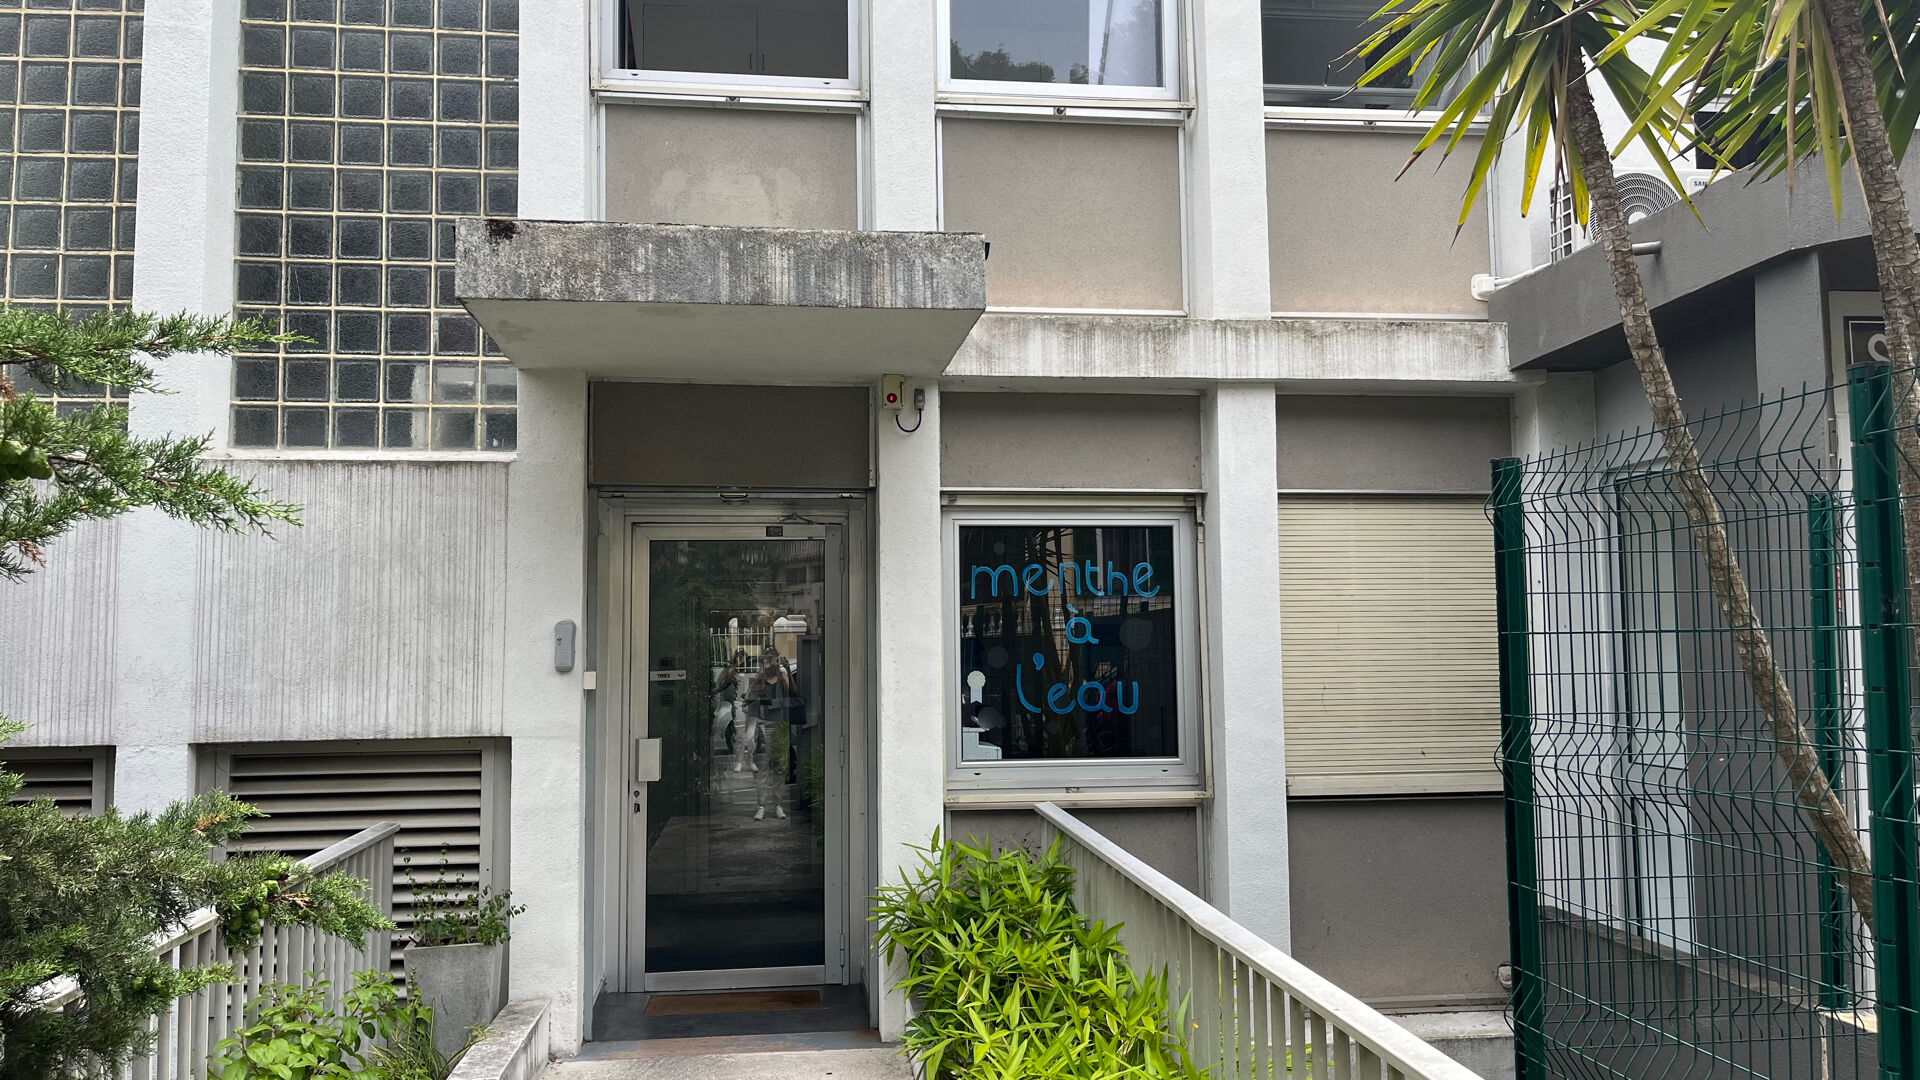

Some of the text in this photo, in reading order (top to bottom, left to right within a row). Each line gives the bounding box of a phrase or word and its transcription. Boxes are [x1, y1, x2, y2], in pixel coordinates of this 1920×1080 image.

[971, 559, 1160, 599] menthe
[1065, 603, 1099, 645] à
[1016, 652, 1139, 715] l'eau
